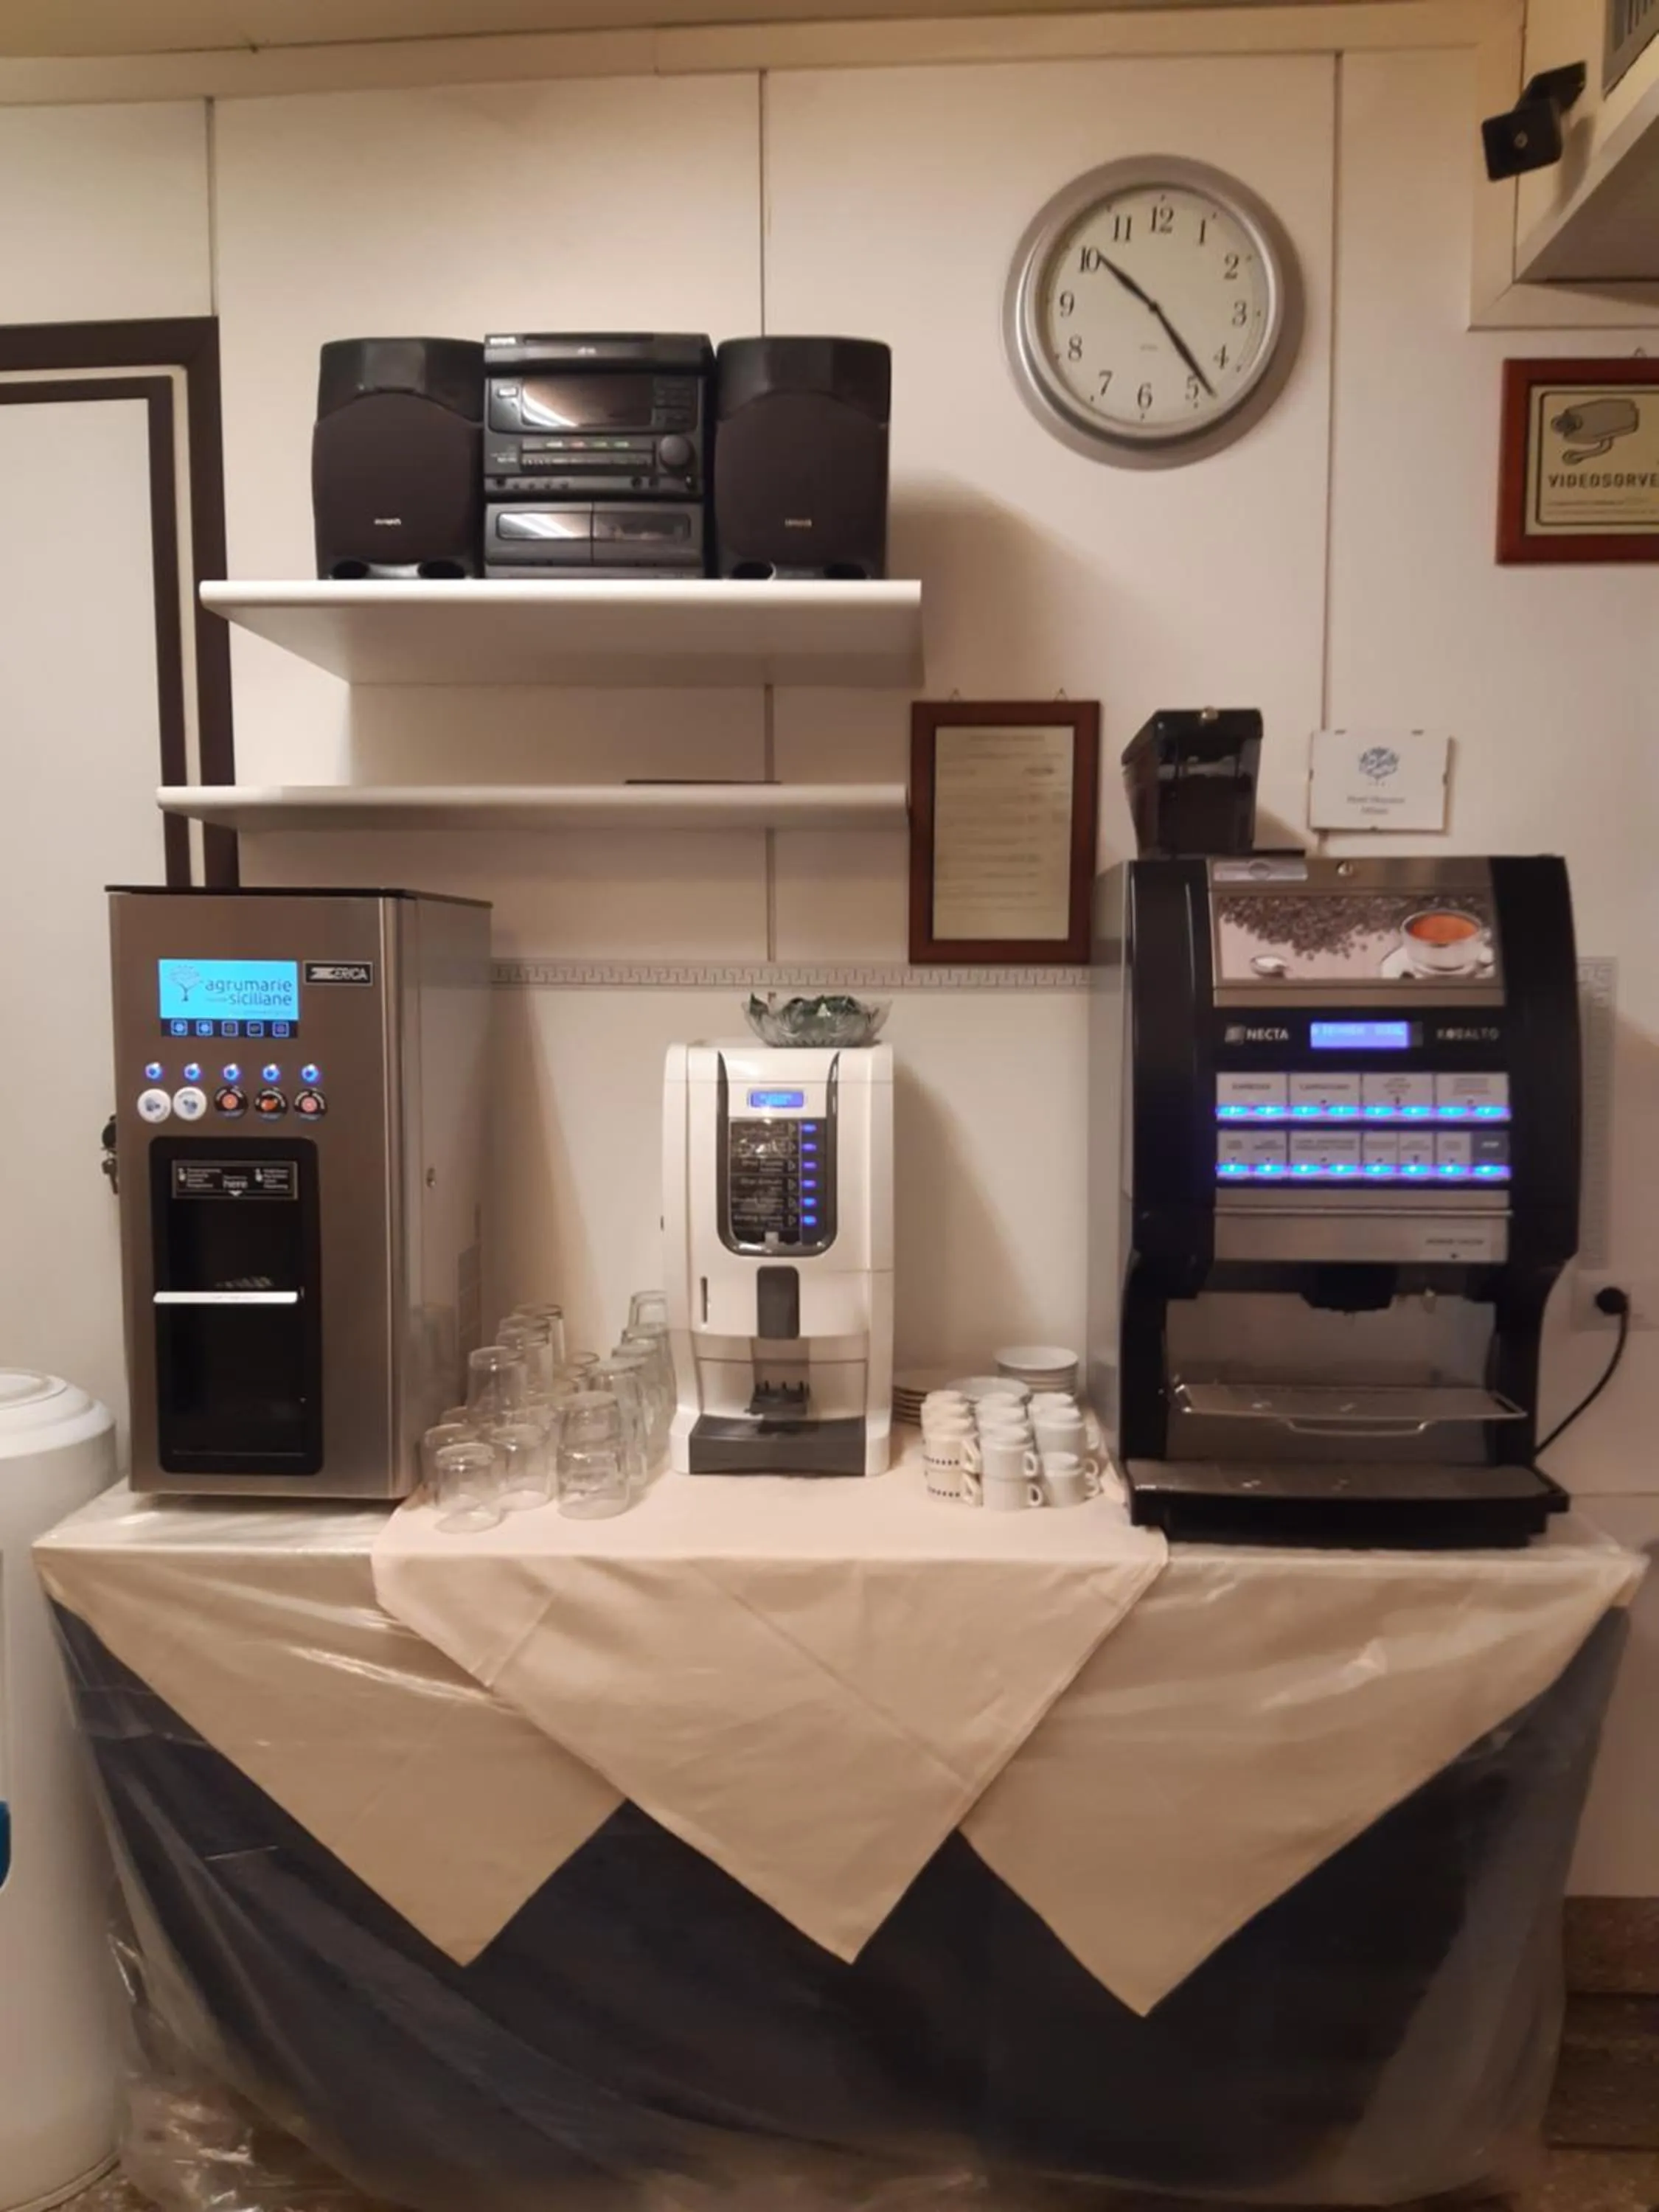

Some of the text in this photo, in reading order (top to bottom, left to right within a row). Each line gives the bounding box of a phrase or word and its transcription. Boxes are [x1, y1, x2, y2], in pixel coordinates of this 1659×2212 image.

[1113, 215, 1132, 242] 11
[1150, 206, 1174, 234] 12
[1199, 218, 1206, 246] 1
[1079, 246, 1101, 274] 10
[1224, 254, 1239, 280] 2
[1060, 292, 1074, 318] 9
[1232, 301, 1247, 327] 3
[1068, 337, 1082, 361] 8
[1214, 344, 1228, 369] 4
[1099, 370, 1113, 396] 7
[1186, 375, 1200, 400] 5
[1137, 383, 1152, 410] 6
[1548, 473, 1659, 488] VIDEOSORVE
[205, 978, 293, 994] agrumarie
[229, 992, 293, 1006] siciliane
[1247, 1028, 1289, 1041] NECTA
